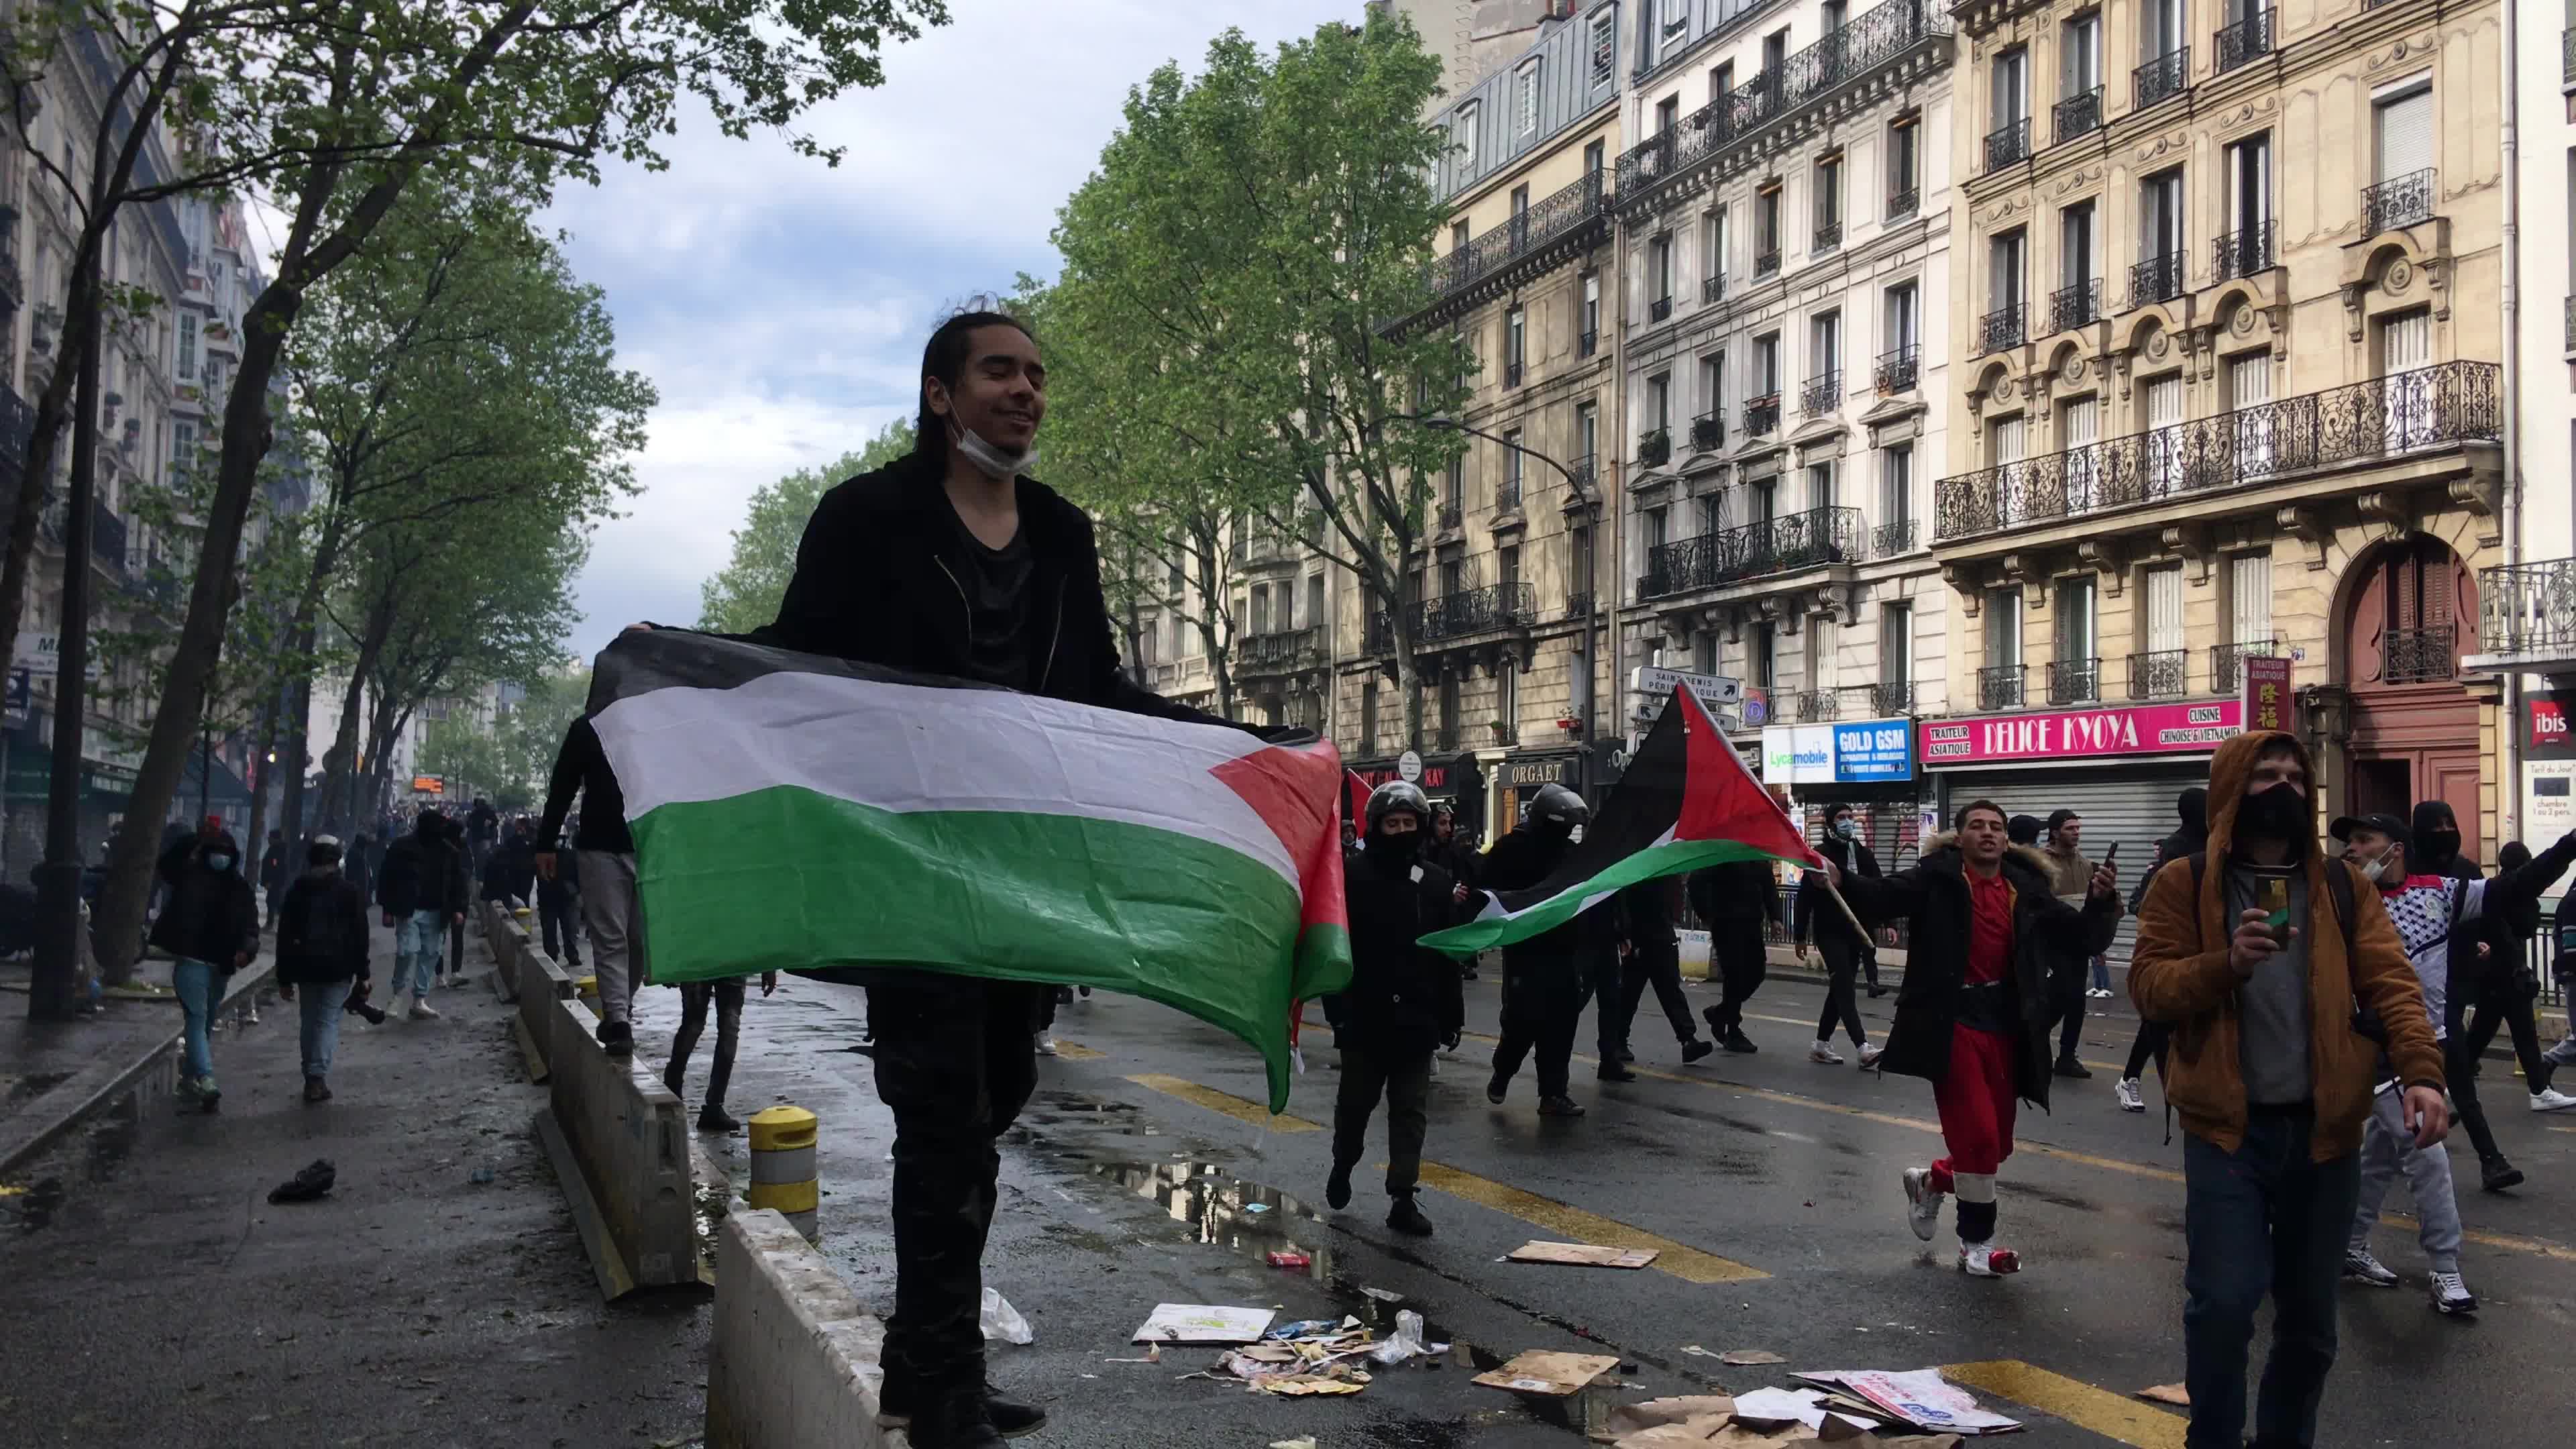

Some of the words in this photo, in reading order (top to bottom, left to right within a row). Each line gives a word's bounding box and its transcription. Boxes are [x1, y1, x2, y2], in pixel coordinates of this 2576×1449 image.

[2253, 660, 2285, 669] TRAITEUR
[2251, 671, 2286, 680] ASIATIQUE
[2189, 708, 2220, 722] CUISINE
[2536, 712, 2567, 733] ibis
[1931, 727, 1968, 739] TRAITEUR
[1984, 718, 2051, 755] DELICE
[2063, 713, 2139, 750] KYOYA
[2160, 729, 2191, 743] CHINOISE
[2193, 729, 2199, 742] &
[1839, 731, 1872, 752] GOLD
[1876, 729, 1905, 751] GSM
[1929, 743, 1970, 756] ASIATIQUE
[1770, 749, 1828, 767] Lycamobile
[2546, 763, 2555, 773] du
[2537, 798, 2567, 808] chambre
